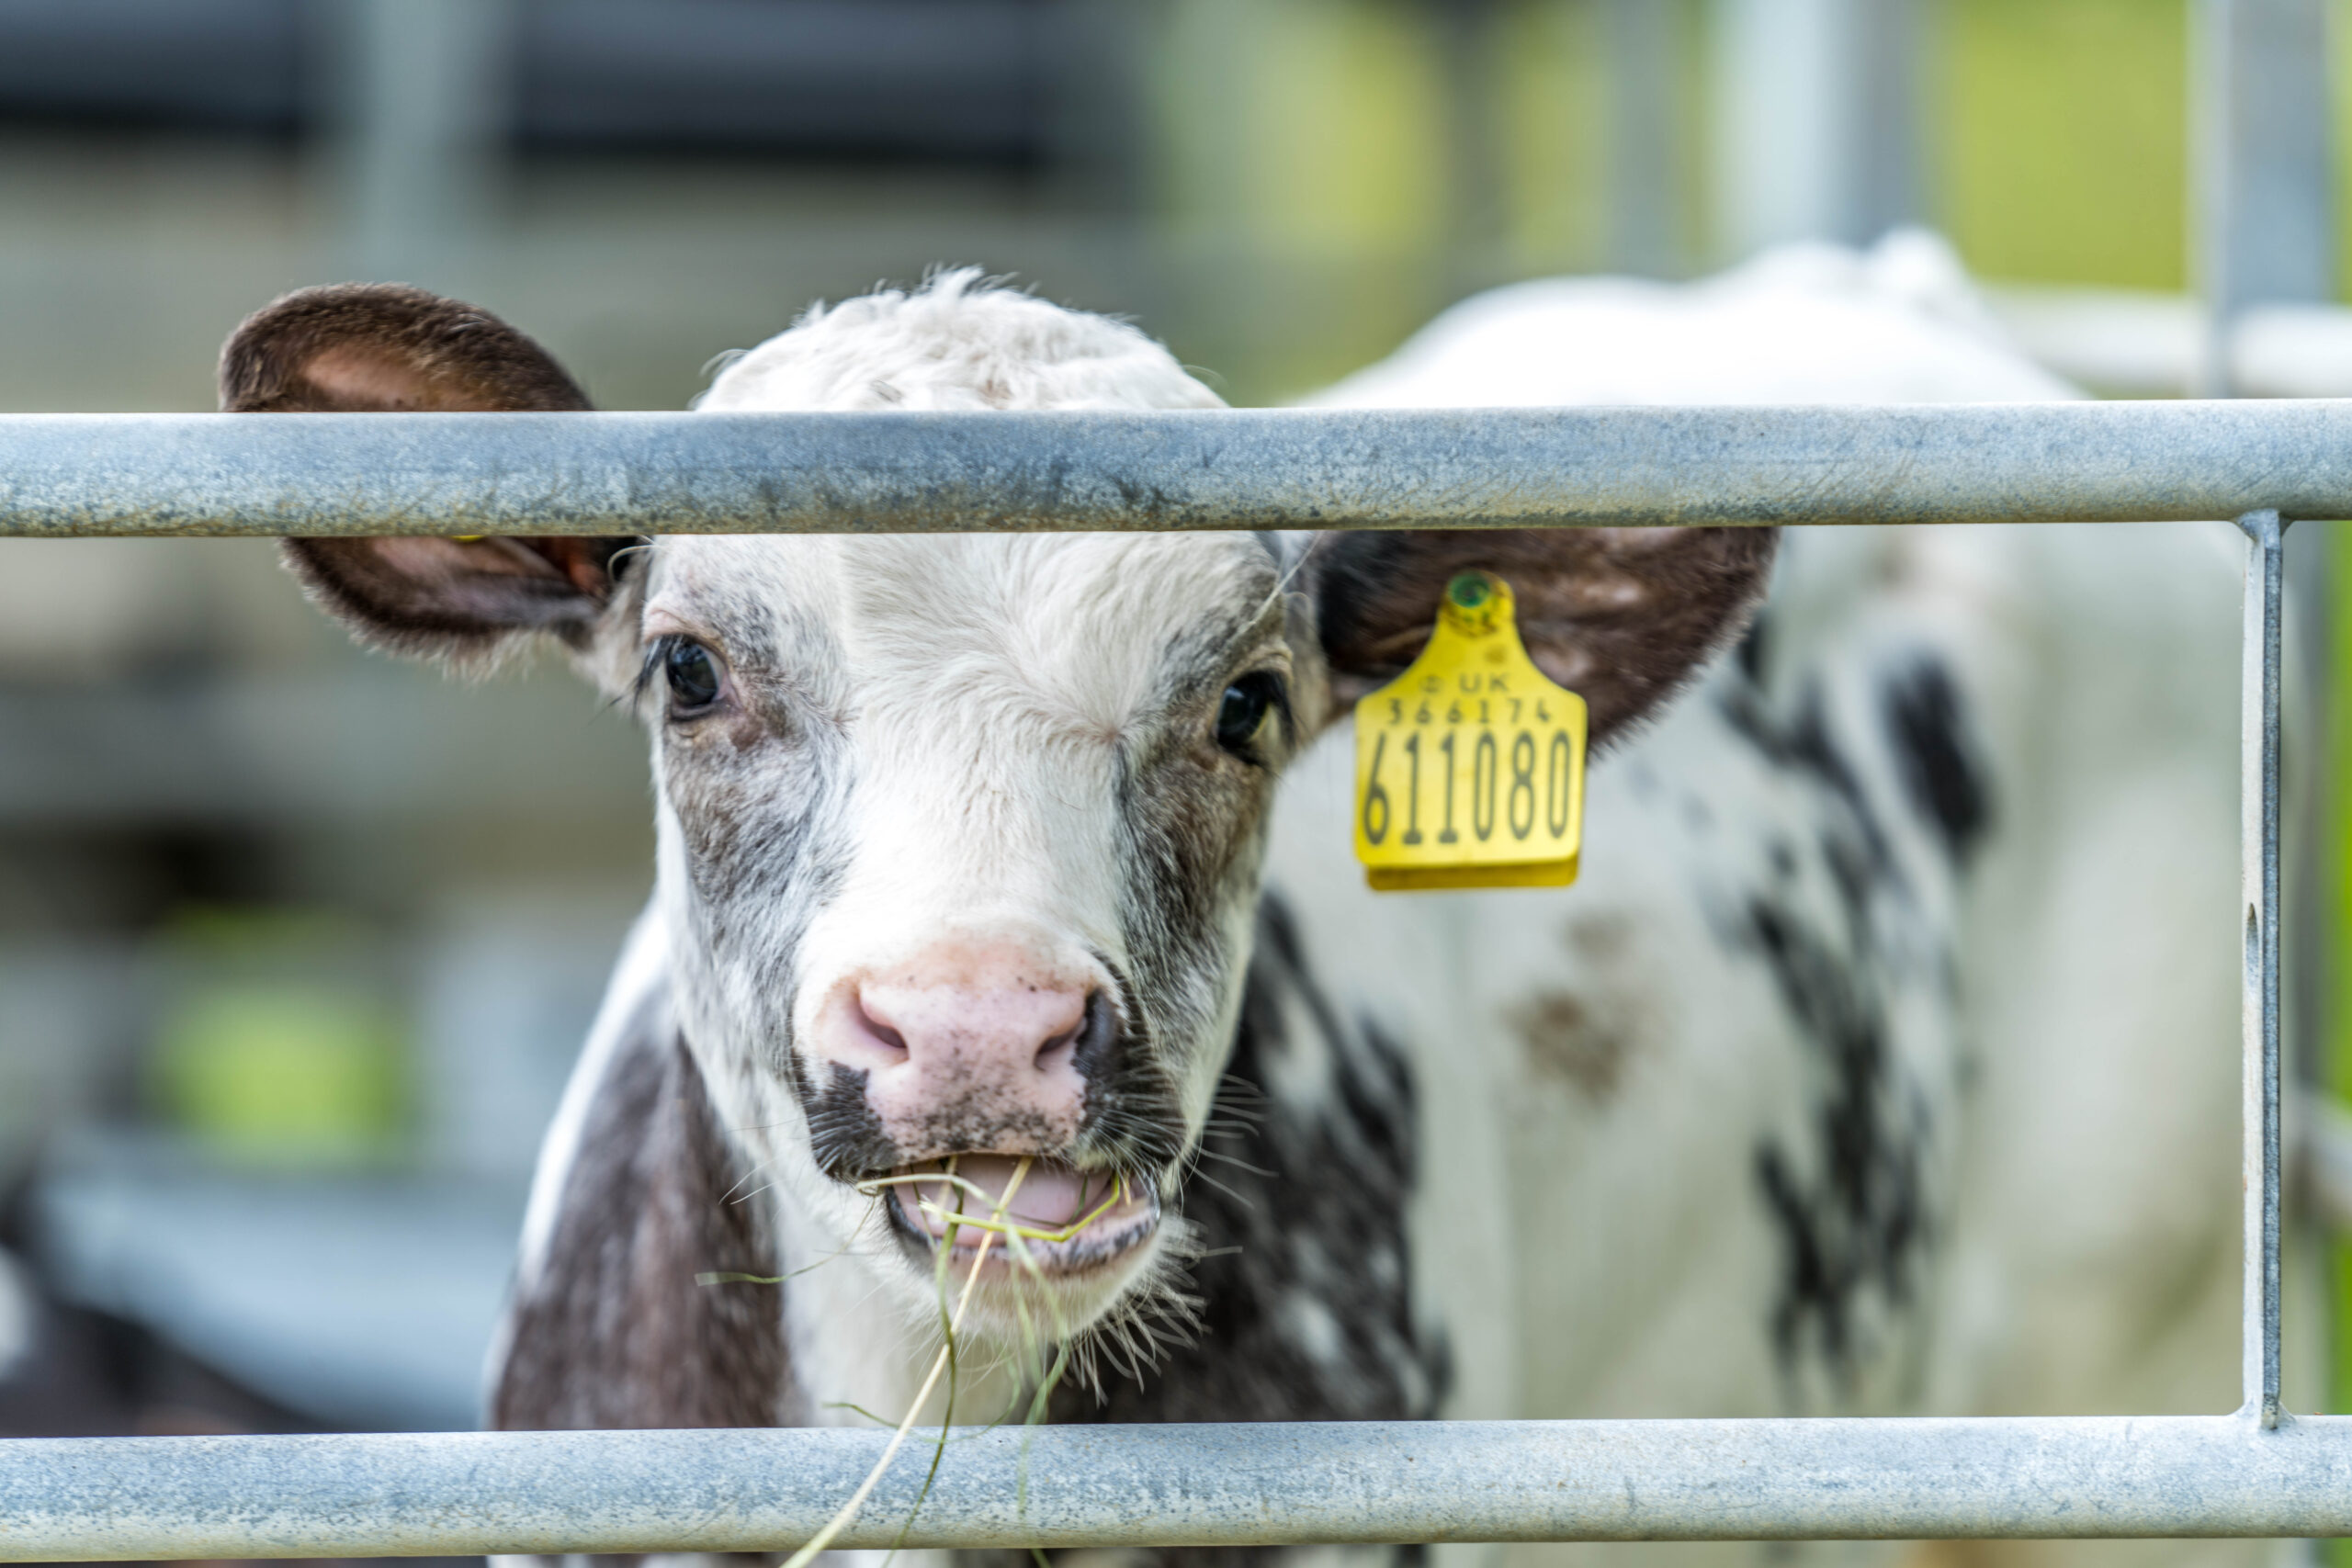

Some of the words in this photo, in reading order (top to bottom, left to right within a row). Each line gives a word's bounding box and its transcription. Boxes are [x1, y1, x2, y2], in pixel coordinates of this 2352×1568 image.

[1459, 673, 1510, 694] UK
[1387, 698, 1552, 725] 366174
[1363, 728, 1571, 846] 611080
